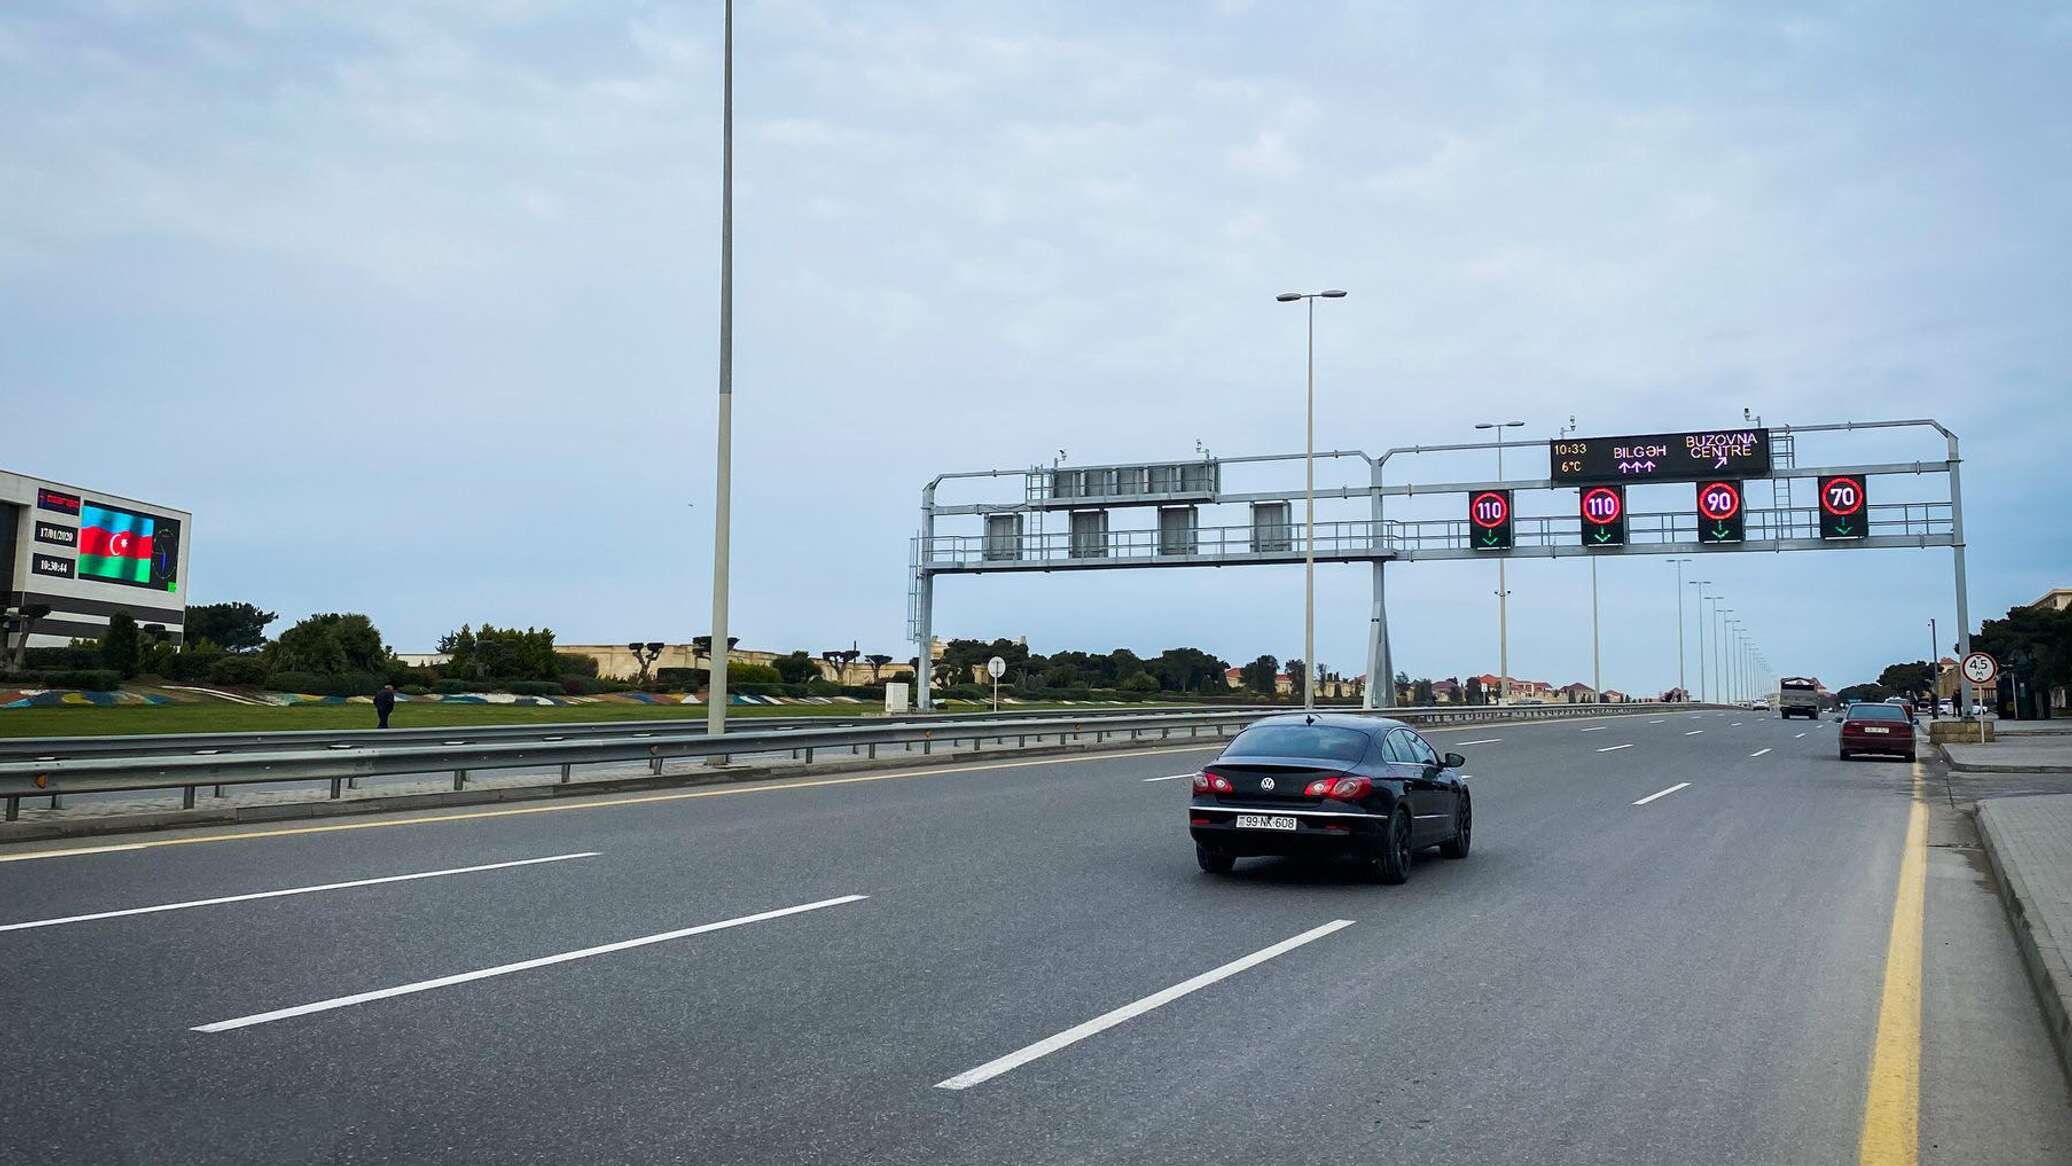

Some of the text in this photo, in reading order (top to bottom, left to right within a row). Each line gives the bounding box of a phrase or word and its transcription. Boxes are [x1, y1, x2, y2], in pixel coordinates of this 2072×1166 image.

[1685, 433, 1758, 447] BUZOVNA
[1554, 443, 1587, 455] 10:33
[1614, 445, 1666, 459] BILGƏH
[1690, 444, 1752, 458] CENTRE
[1707, 492, 1731, 511] 90
[1830, 487, 1855, 506] 70
[1478, 502, 1501, 519] 110
[1589, 497, 1615, 516] 110
